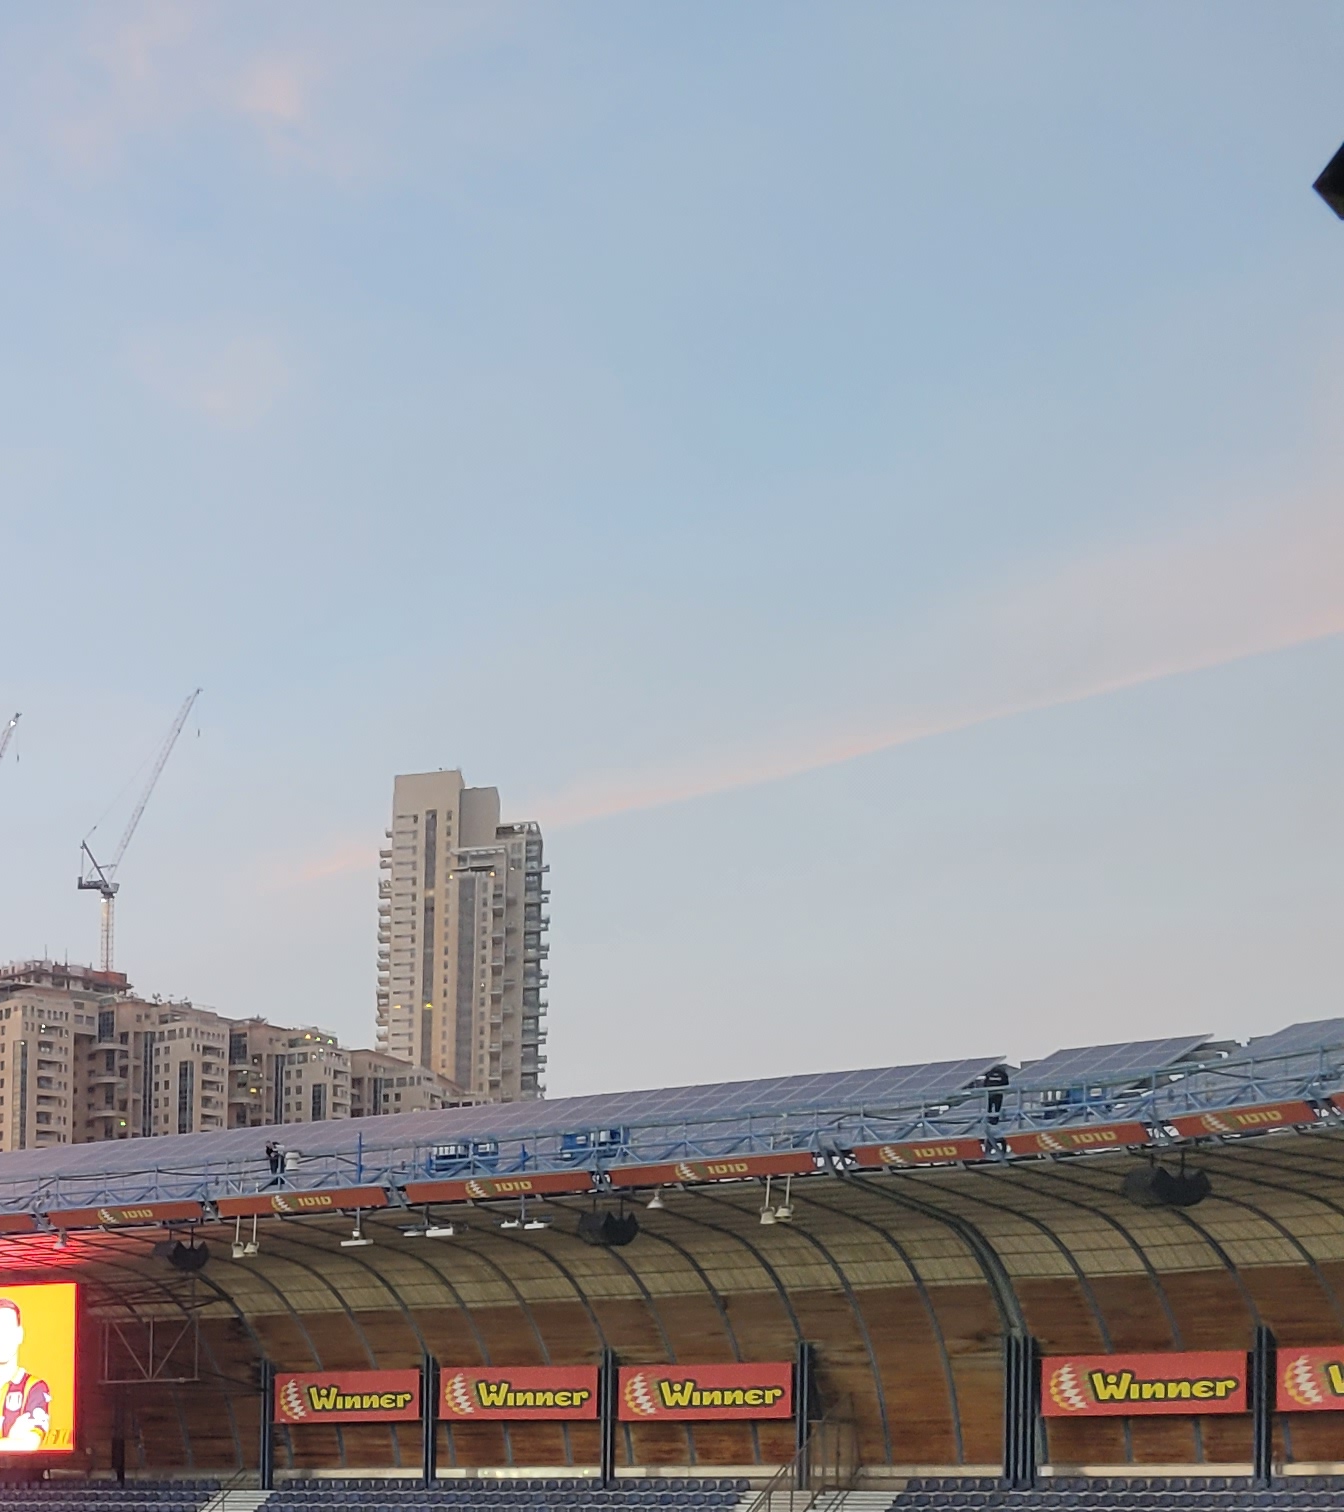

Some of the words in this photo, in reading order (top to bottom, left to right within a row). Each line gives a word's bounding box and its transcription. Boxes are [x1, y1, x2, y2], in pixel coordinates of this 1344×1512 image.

[1235, 1110, 1283, 1125] טוטו
[1071, 1131, 1117, 1145] טוטו
[914, 1146, 957, 1158] טוטו
[707, 1162, 747, 1174] טוטו
[494, 1180, 532, 1193] טוטו
[297, 1195, 332, 1207] טוטו
